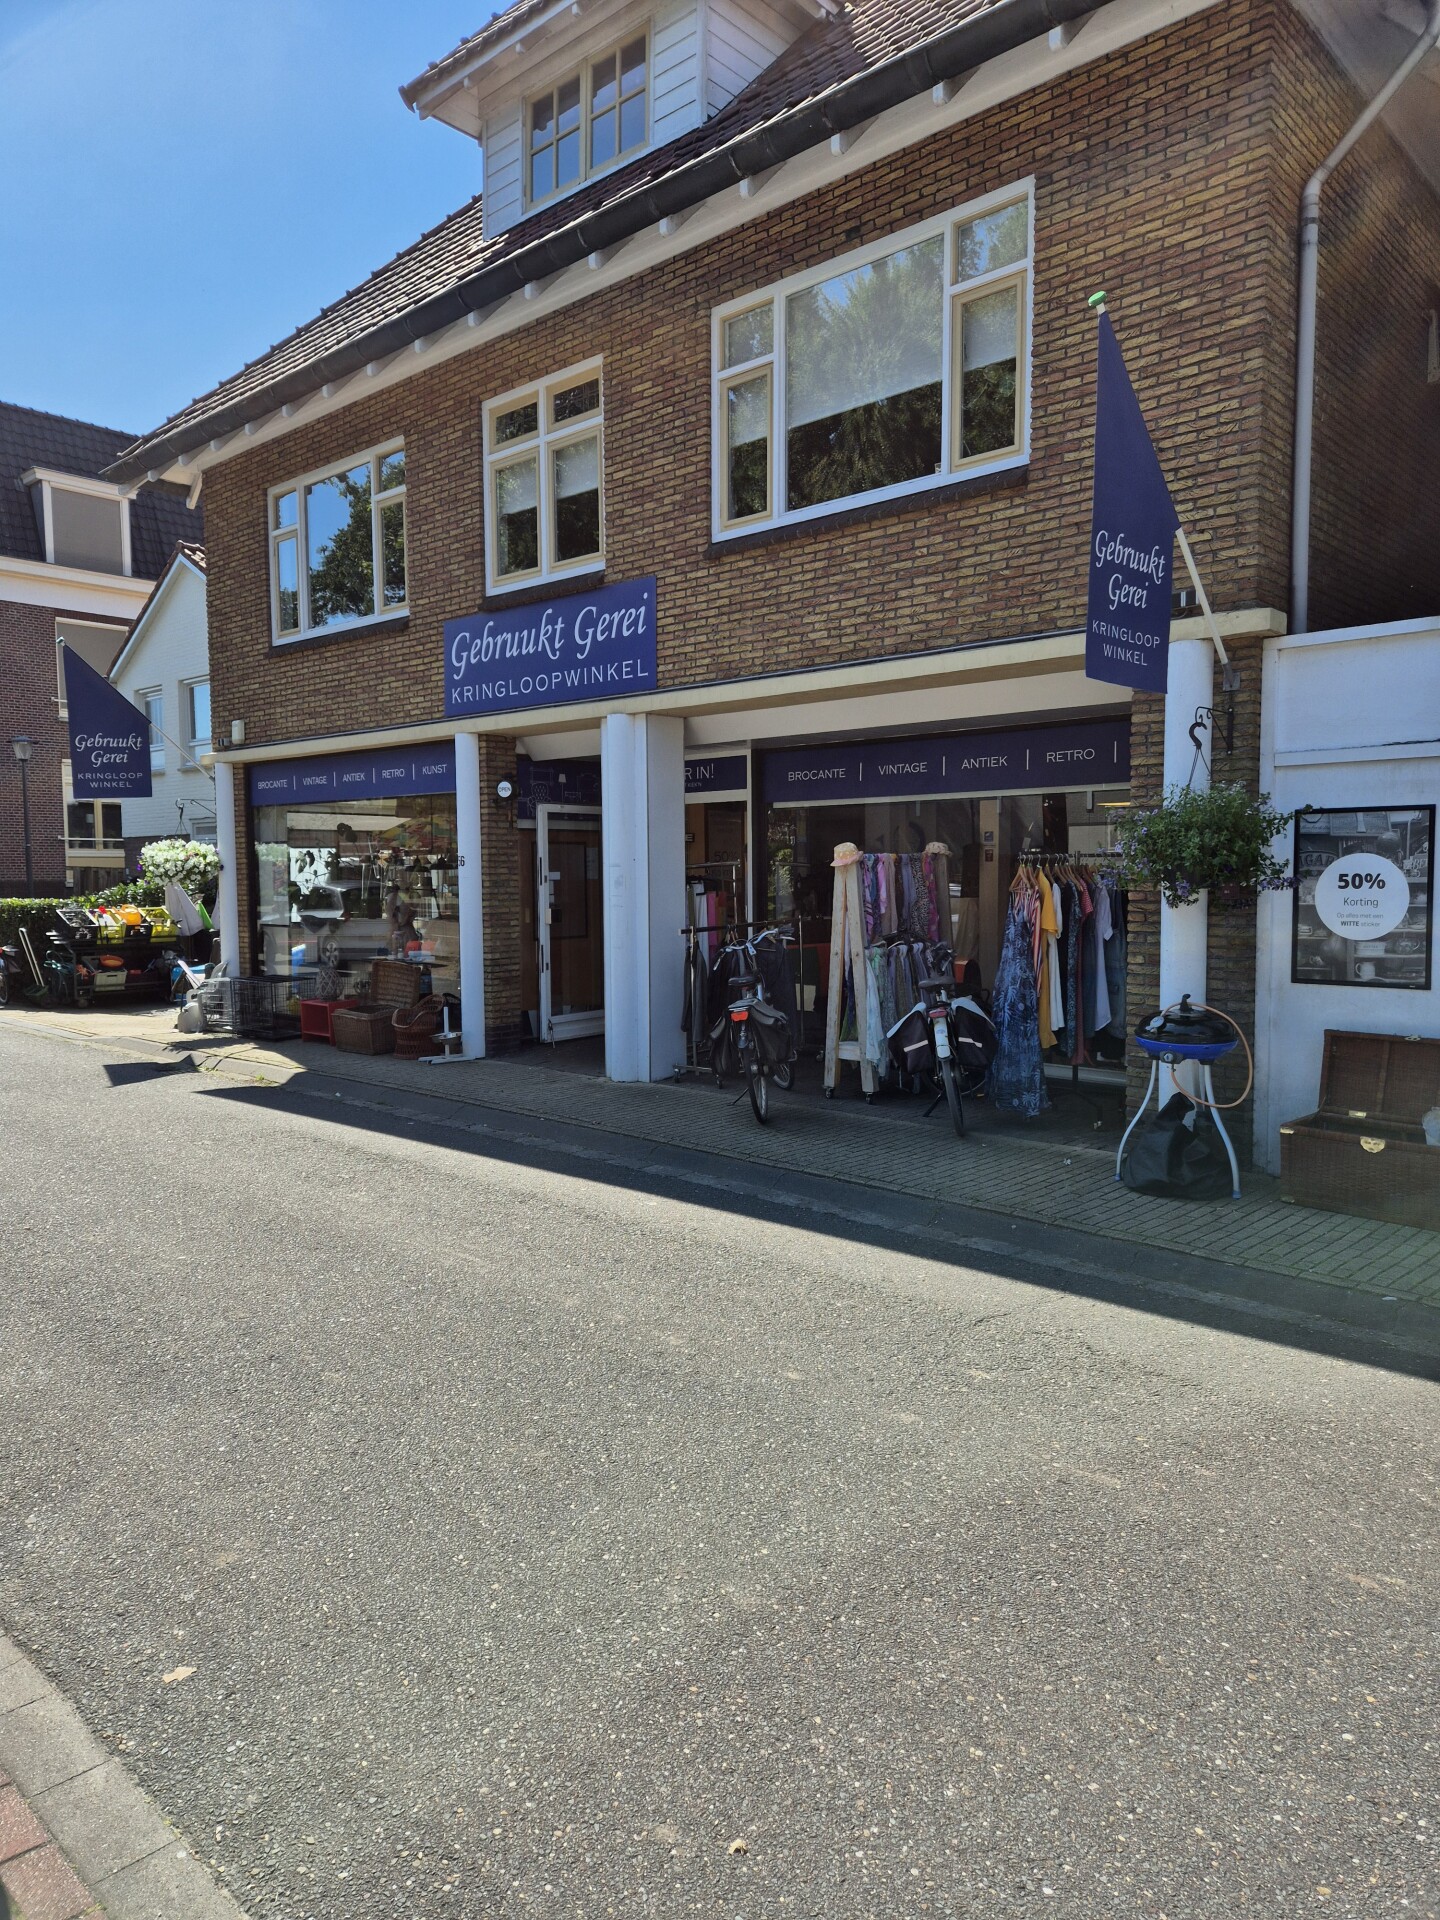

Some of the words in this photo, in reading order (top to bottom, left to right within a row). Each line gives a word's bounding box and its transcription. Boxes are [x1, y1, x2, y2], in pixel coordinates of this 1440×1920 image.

[1095, 530, 1166, 584] Gebruukt
[1108, 573, 1149, 610] Gerei
[451, 608, 565, 680] Gebruukt
[574, 592, 648, 660] Gerei
[1092, 620, 1160, 648] KRINGLOOP
[1103, 643, 1148, 666] WINKEL
[451, 658, 649, 704] KRINGLOOPWINKEL
[75, 733, 142, 752] Gebruukt
[91, 750, 129, 768] Gerei
[788, 768, 846, 781] BROCANTE
[878, 761, 927, 776] VINTAGE
[961, 755, 1008, 770] ANTIEK
[1046, 748, 1096, 763] RETRO
[77, 772, 143, 780] KRINGLOOP
[257, 779, 288, 790] BROCANTE
[302, 776, 327, 786] VINTAGE
[342, 772, 365, 782] ANTIEK
[381, 768, 405, 779] RETRO
[422, 764, 447, 775] KUNST
[696, 763, 714, 780] IN!
[1337, 873, 1386, 890] 50%
[1343, 897, 1379, 908] Korting
